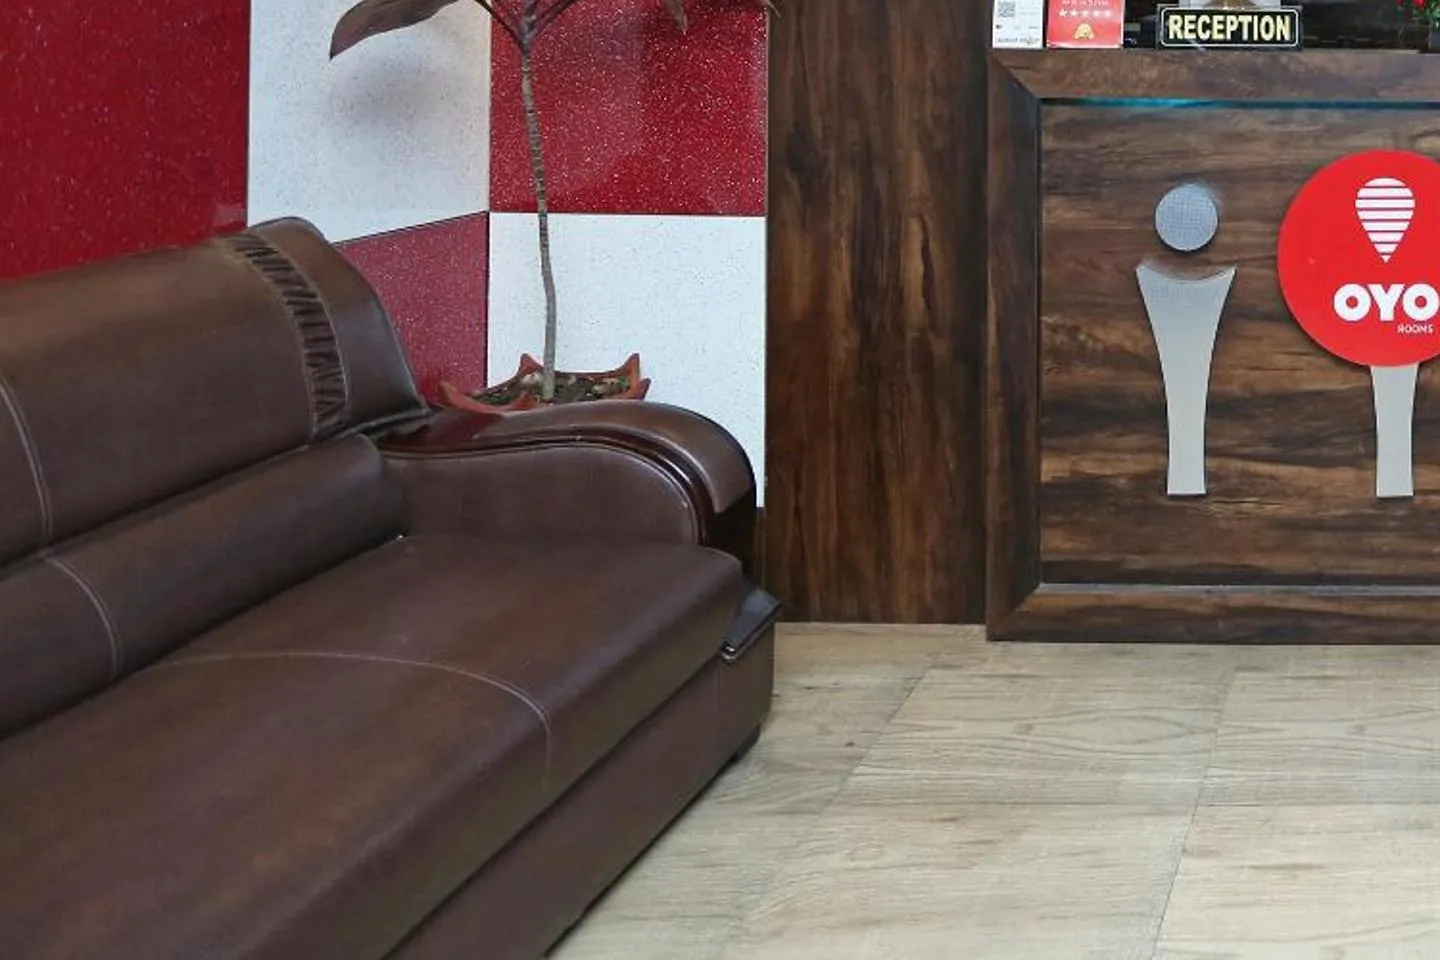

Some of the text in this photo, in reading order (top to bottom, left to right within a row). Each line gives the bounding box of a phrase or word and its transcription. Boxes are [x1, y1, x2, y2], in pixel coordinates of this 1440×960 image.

[1168, 14, 1291, 41] RECEPTION
[1333, 283, 1440, 322] OYO
[1397, 323, 1434, 335] ROOMS
